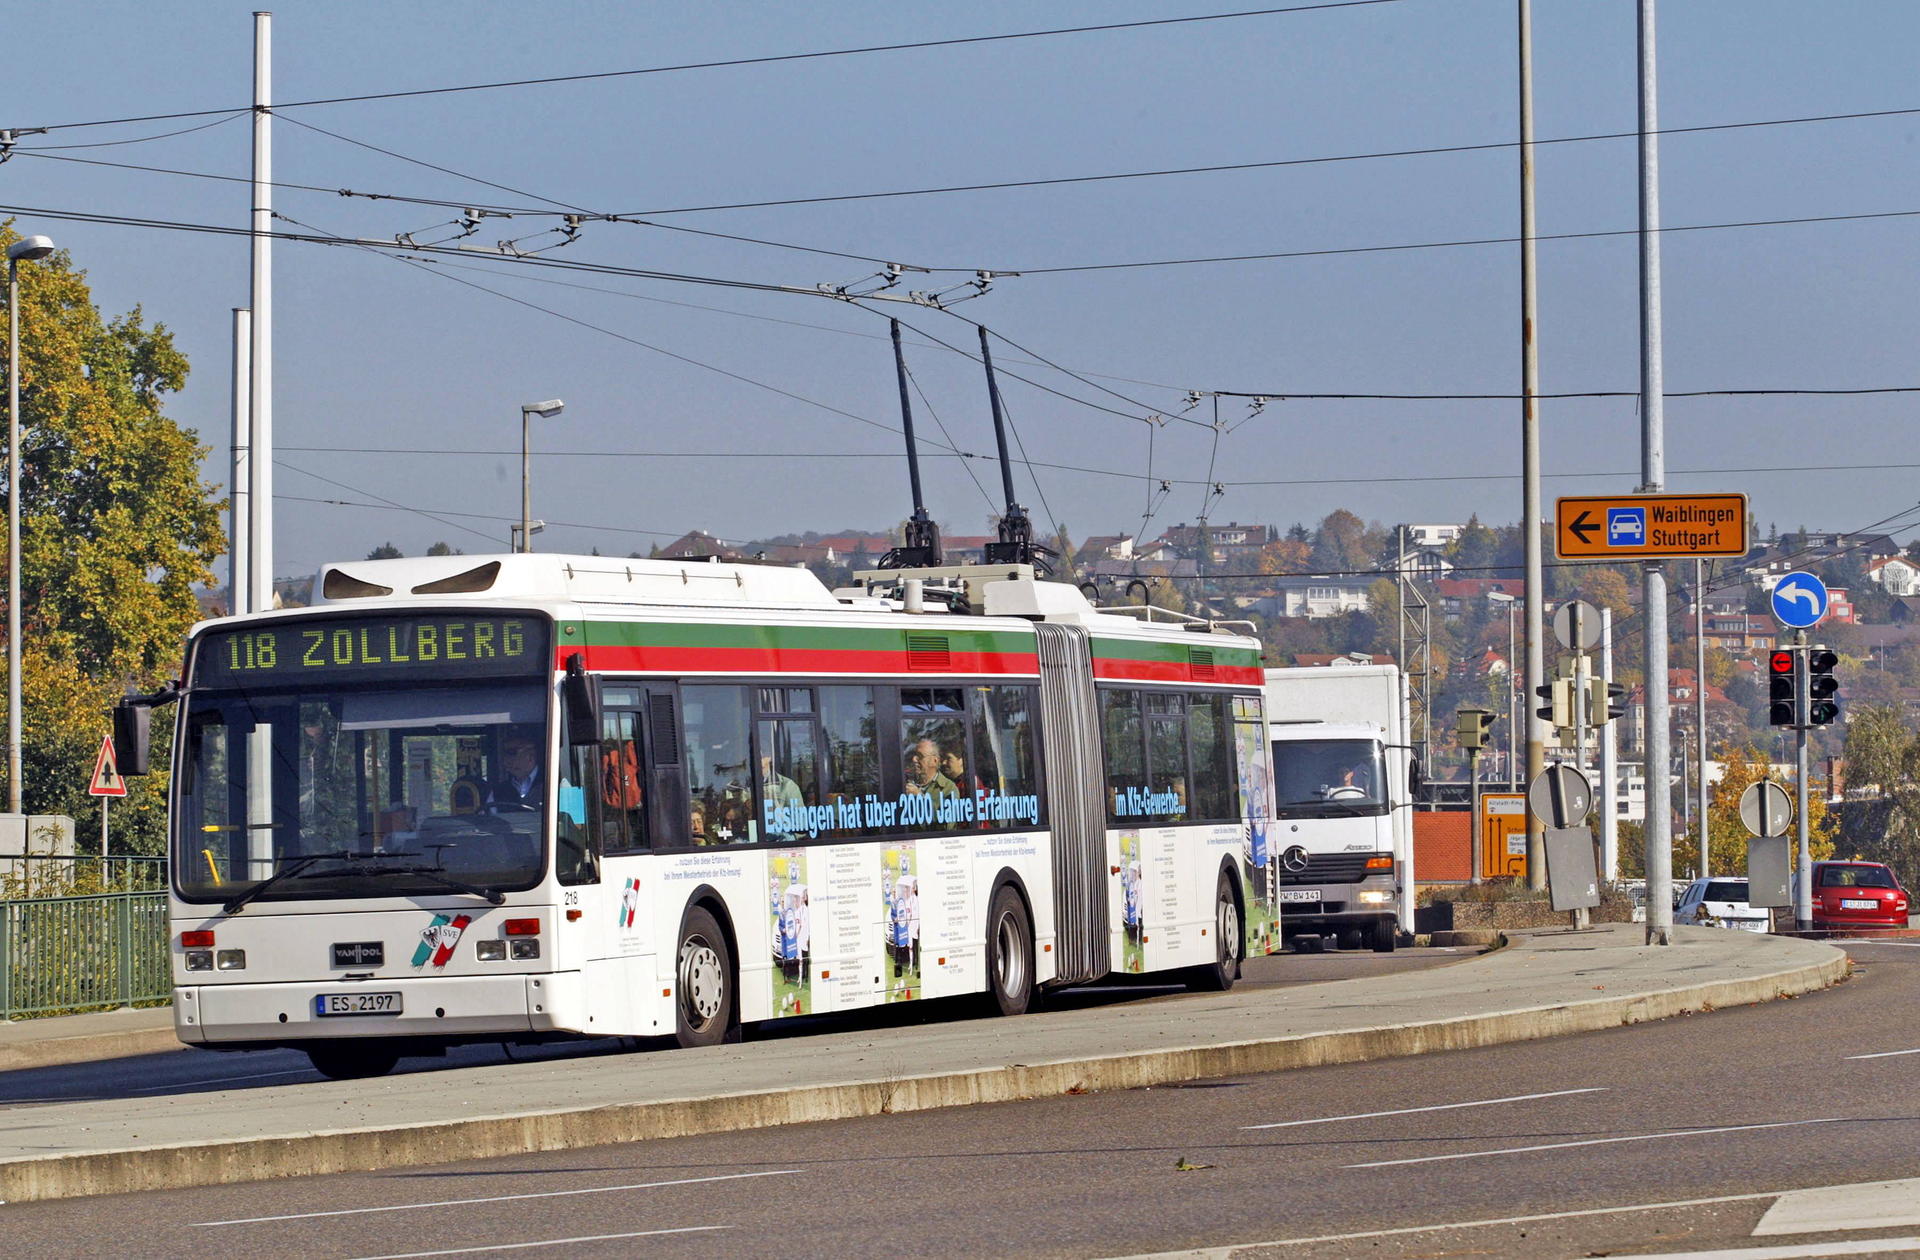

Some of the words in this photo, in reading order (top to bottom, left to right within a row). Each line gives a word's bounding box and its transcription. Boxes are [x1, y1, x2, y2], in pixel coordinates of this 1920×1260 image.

[1652, 505, 1734, 526] Waiblingen
[1652, 529, 1720, 550] Stuttgart
[226, 633, 276, 669] 118
[302, 621, 523, 666] ZOLLBERG
[1115, 786, 1127, 816] im
[764, 797, 835, 839] Esslingen
[837, 796, 862, 829] hat
[865, 794, 897, 828] über
[900, 792, 933, 826] 2000
[936, 791, 974, 824] Jahre
[975, 789, 1038, 825] Erfahrung
[564, 891, 578, 906] 218
[1305, 891, 1319, 900] 141
[443, 928, 458, 939] SVE
[332, 997, 349, 1011] ES
[359, 995, 393, 1011] 2197
